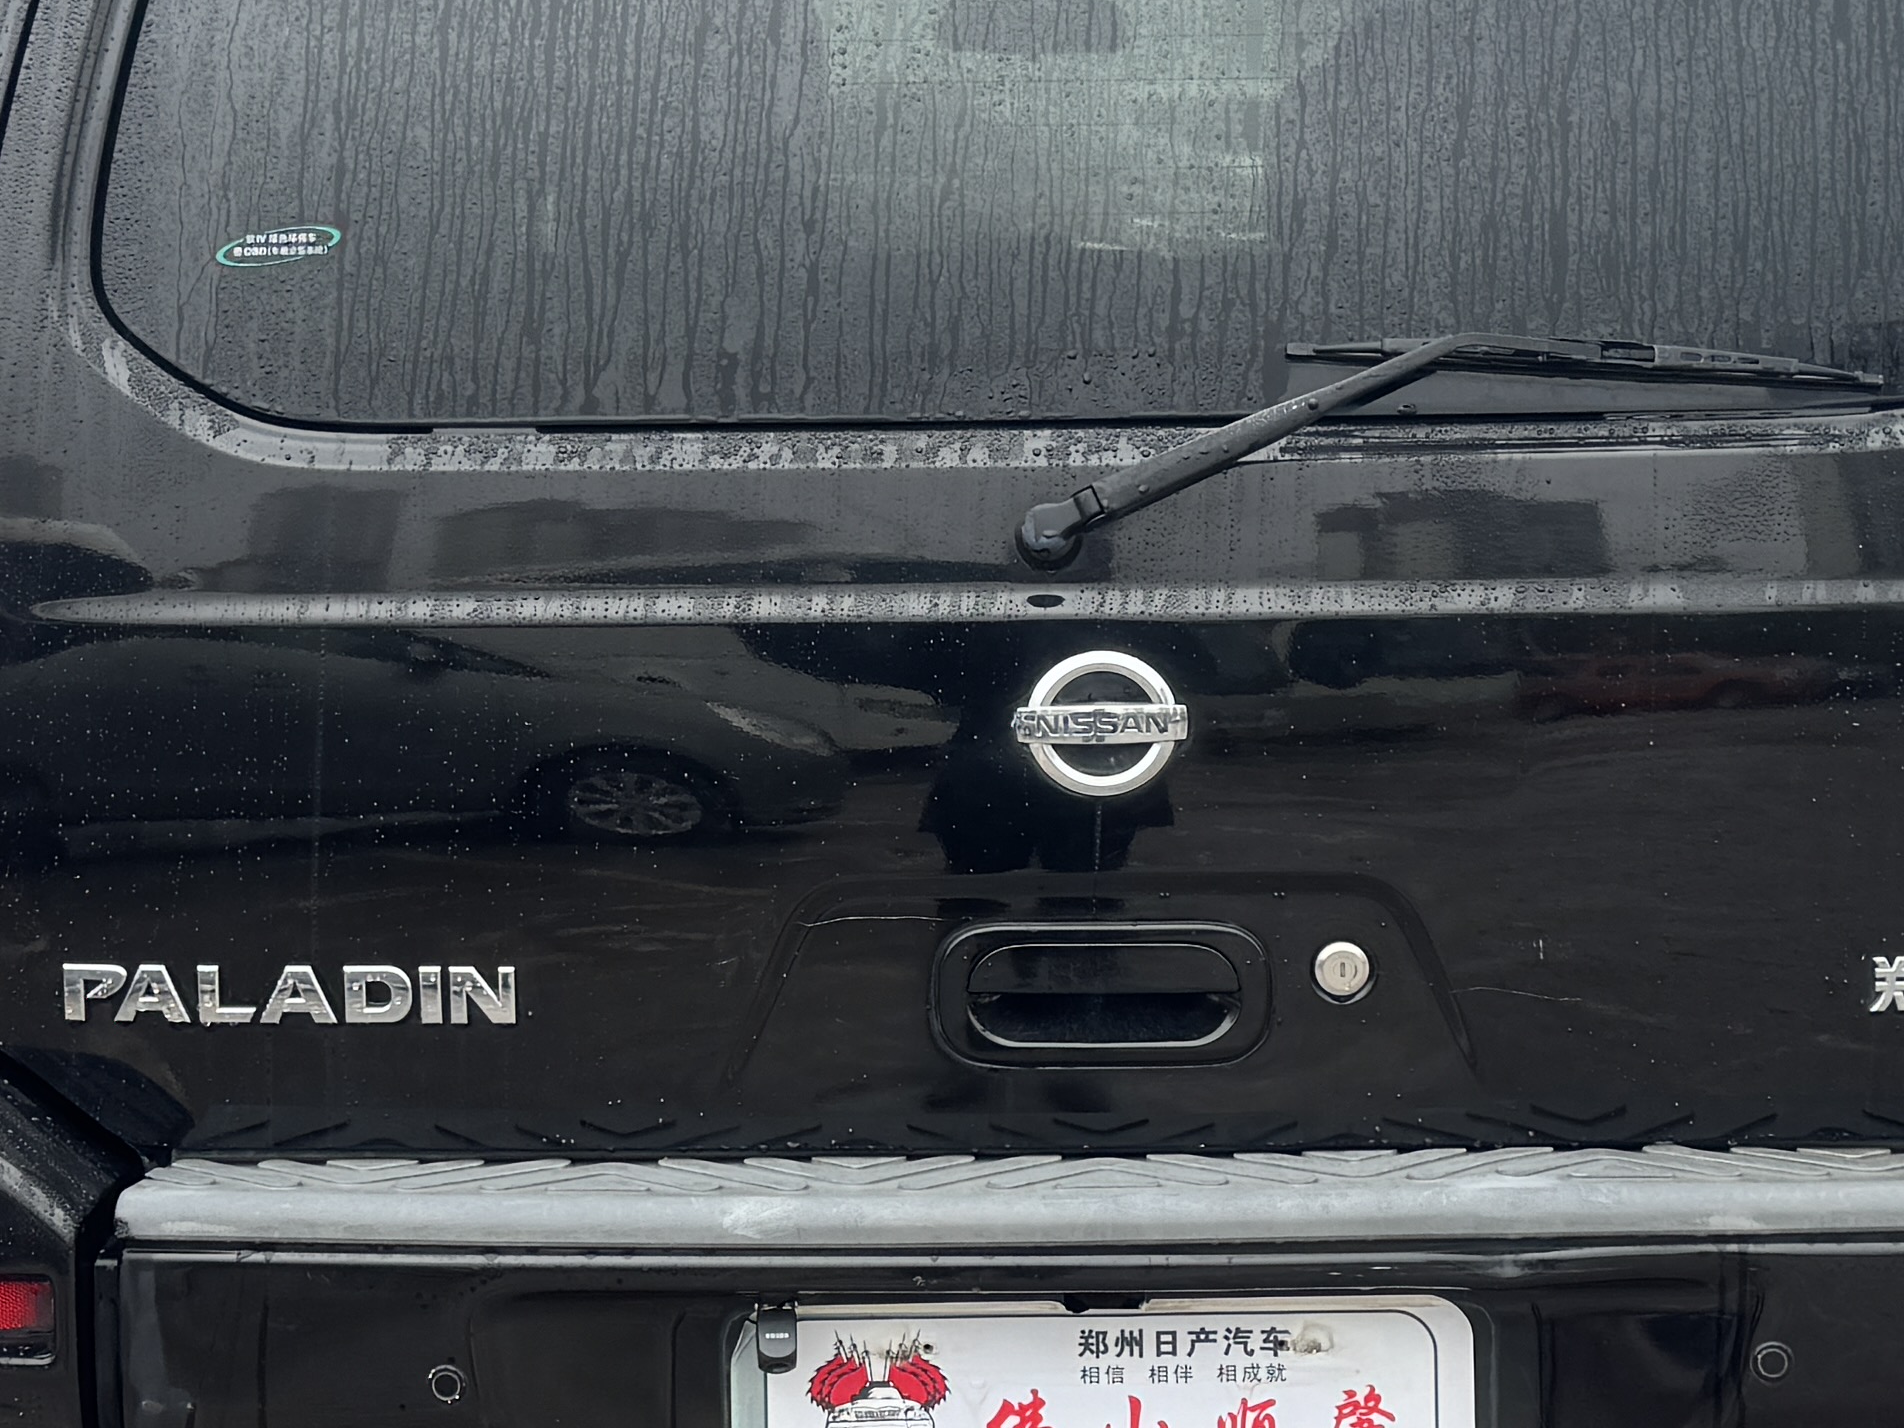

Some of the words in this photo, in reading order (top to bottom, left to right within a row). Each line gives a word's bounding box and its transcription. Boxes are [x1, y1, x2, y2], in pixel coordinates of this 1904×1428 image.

[1033, 710, 1170, 738] NISSAN
[62, 963, 517, 1025] PALADIN
[1078, 1326, 1292, 1359] 郑州日产汽车
[1080, 1364, 1125, 1385] 相信
[1148, 1363, 1194, 1385] 相伴
[1217, 1362, 1287, 1384] 相成就
